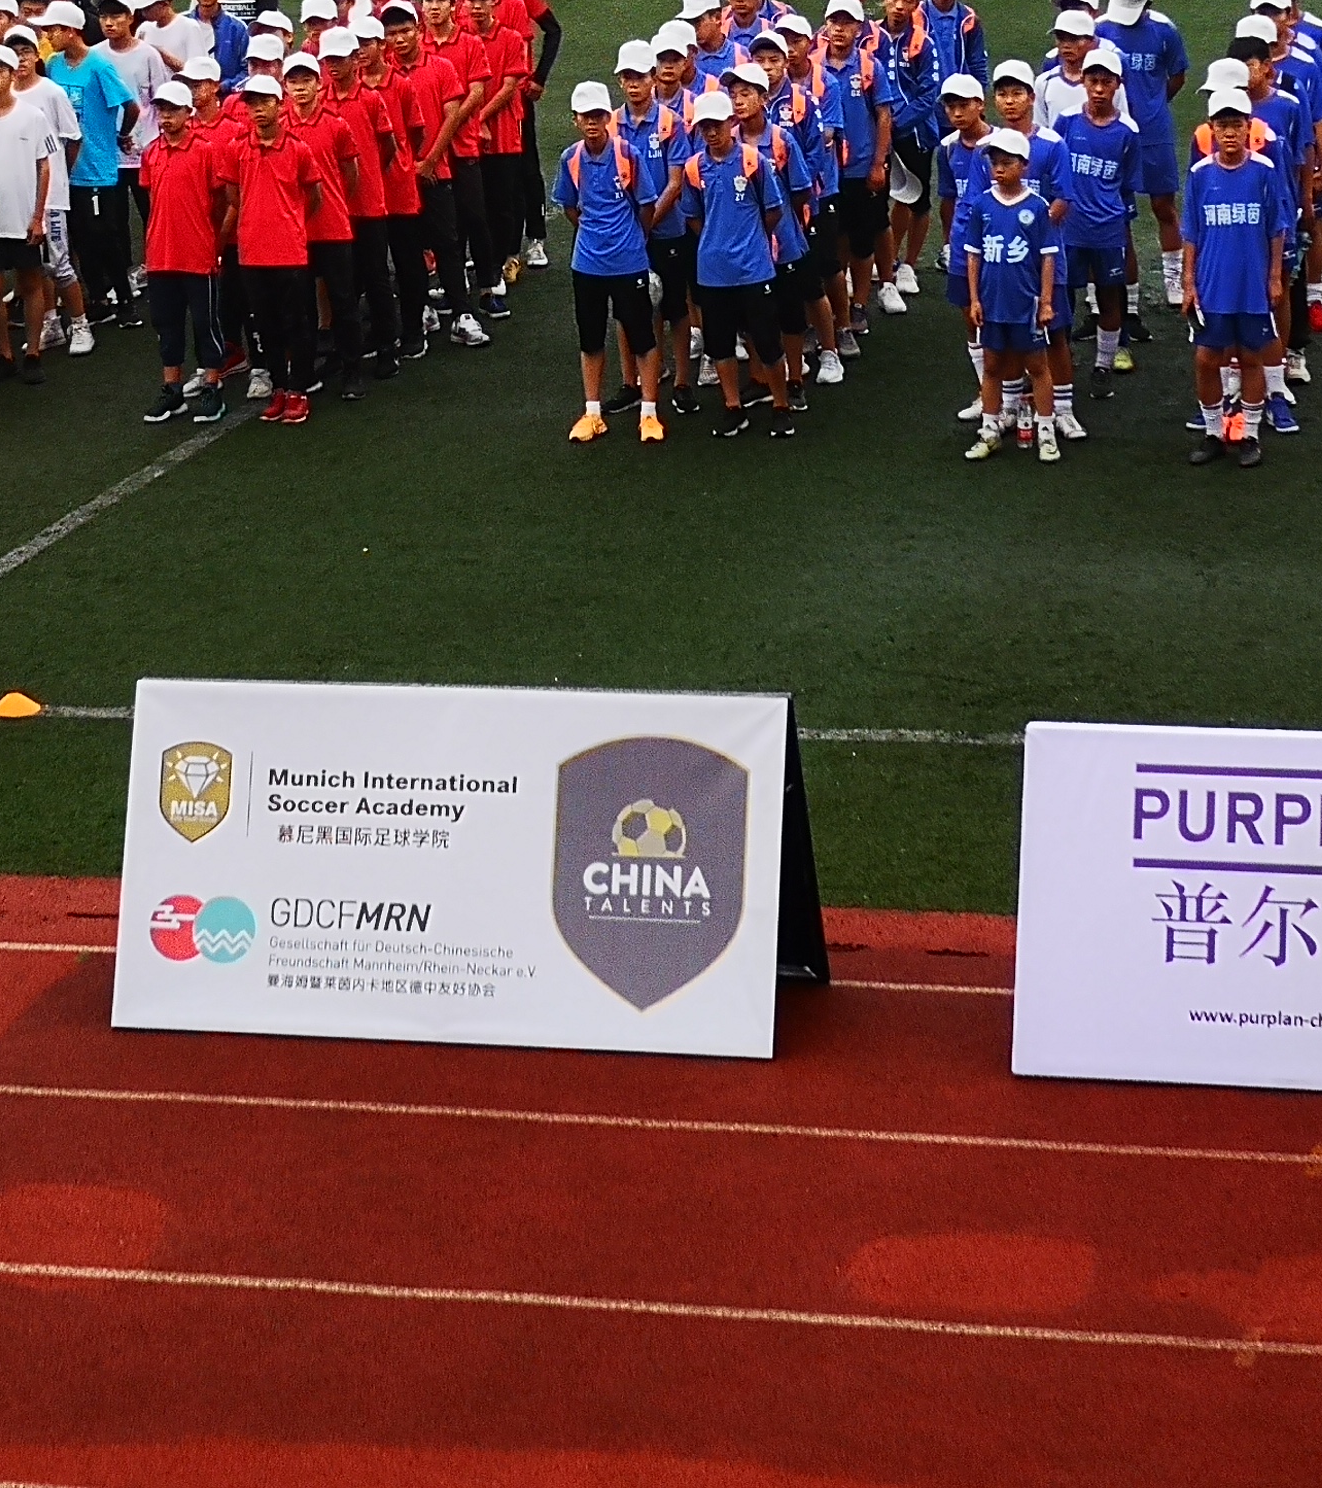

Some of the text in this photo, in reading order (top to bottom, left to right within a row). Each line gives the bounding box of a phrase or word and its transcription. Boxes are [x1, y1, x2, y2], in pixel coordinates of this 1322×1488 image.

[982, 234, 1030, 263] 新乡
[268, 769, 519, 794] Munich International
[171, 801, 218, 817] MISA
[268, 794, 465, 823] Soccer Academy
[277, 824, 451, 850] 慕尼黑国际足球学院
[583, 862, 711, 899] CHINA
[271, 897, 432, 932] GDCFMRN
[584, 896, 711, 916] TALENTS
[269, 936, 514, 959] Gesellschaft für Deutsch-Chinesische
[268, 954, 350, 971] Freundschaft
[353, 957, 511, 978] Mannheim/Rhein-Neckar
